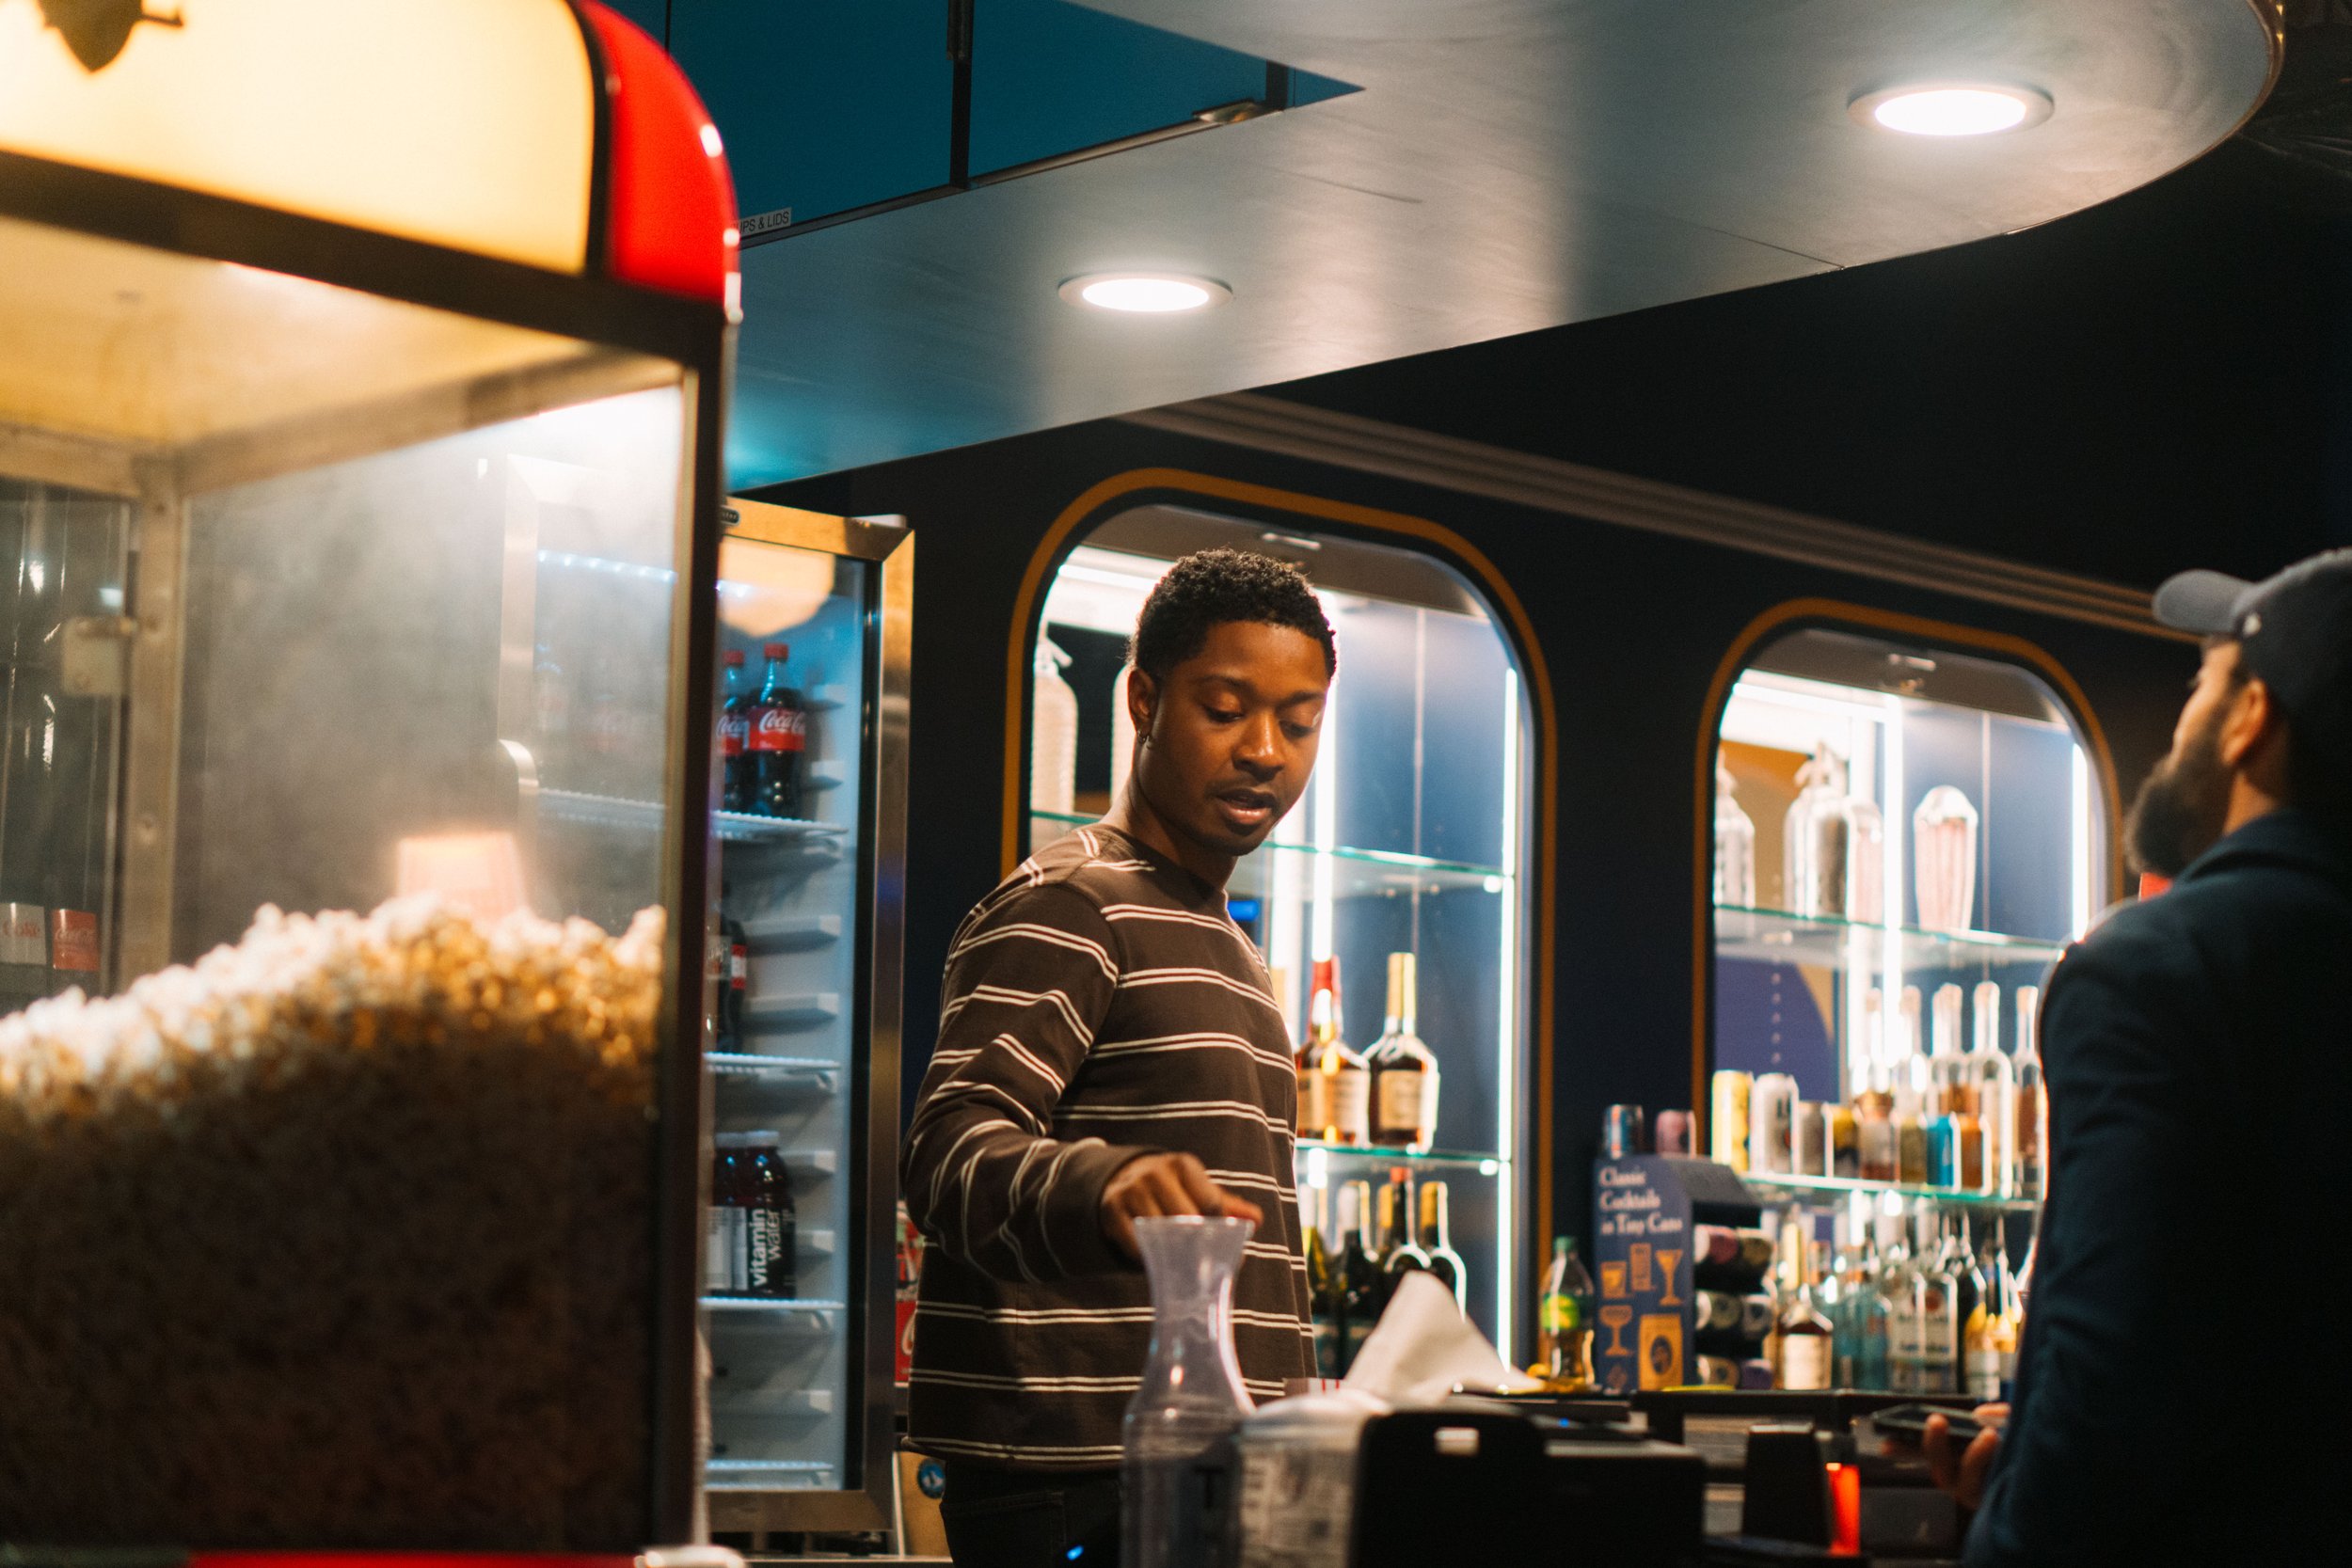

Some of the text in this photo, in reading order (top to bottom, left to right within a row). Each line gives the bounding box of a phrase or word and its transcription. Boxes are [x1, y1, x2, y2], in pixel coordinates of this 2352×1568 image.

[736, 211, 789, 233] UPS & LIDS
[767, 1210, 783, 1260] water
[1615, 1213, 1645, 1236] Tiny
[750, 1209, 768, 1287] vitamin
